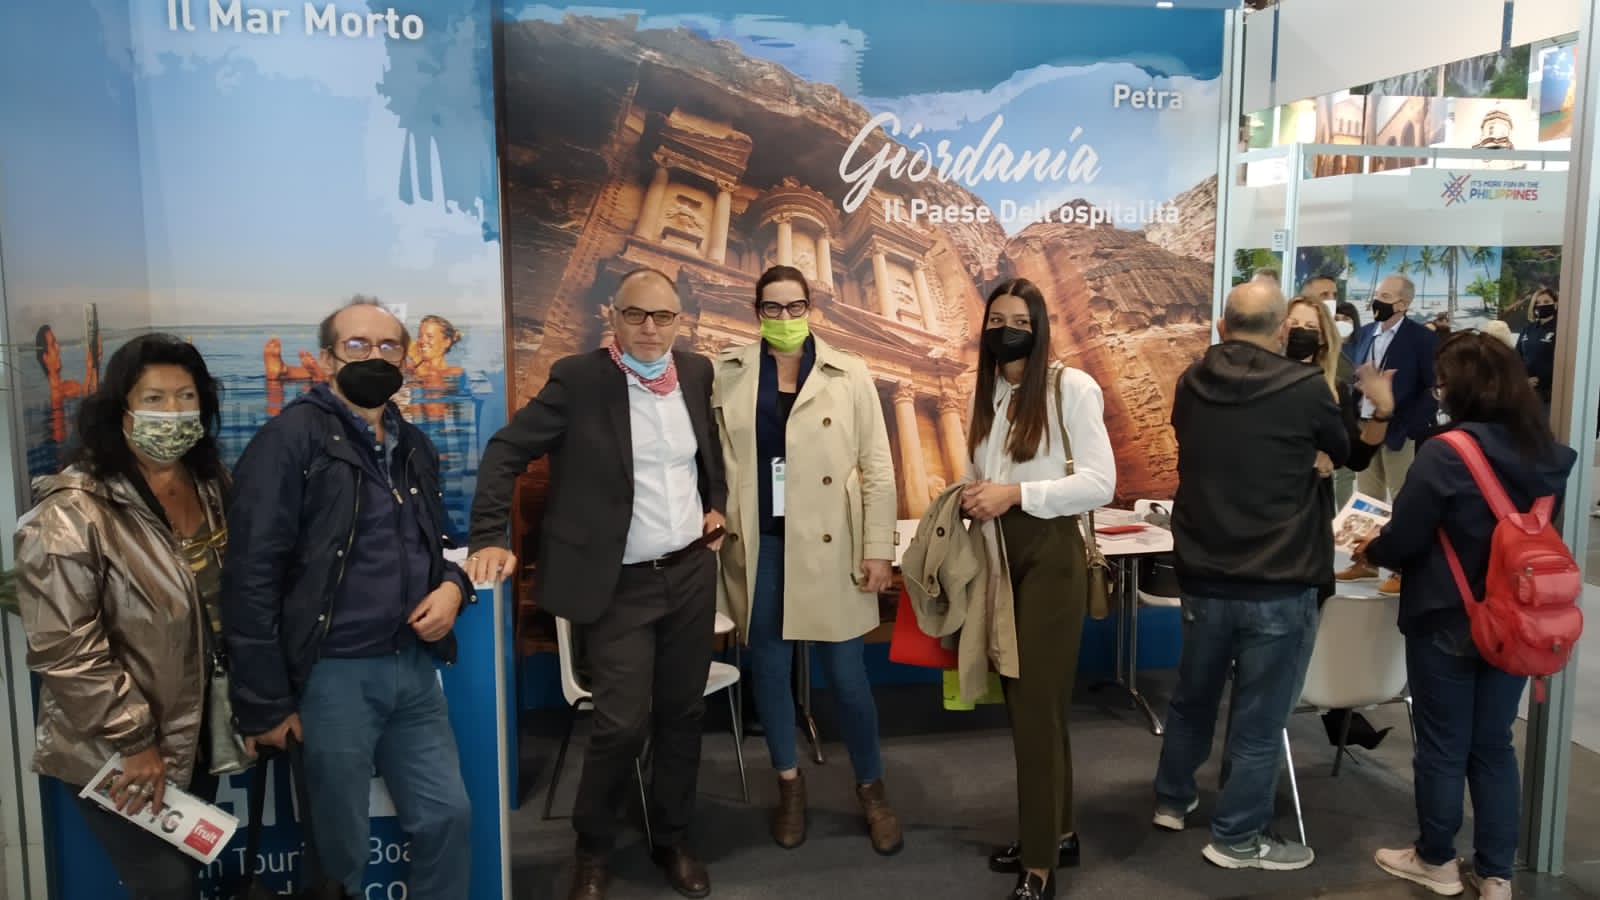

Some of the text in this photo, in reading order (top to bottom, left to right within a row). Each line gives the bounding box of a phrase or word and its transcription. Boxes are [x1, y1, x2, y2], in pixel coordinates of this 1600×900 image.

[168, 0, 424, 40] Il Mar Morto
[1113, 84, 1184, 110] Petra
[838, 112, 1103, 213] Giordania
[1470, 188, 1538, 200] PHILIPPINES
[884, 200, 901, 223] Il
[910, 199, 991, 224] Paese
